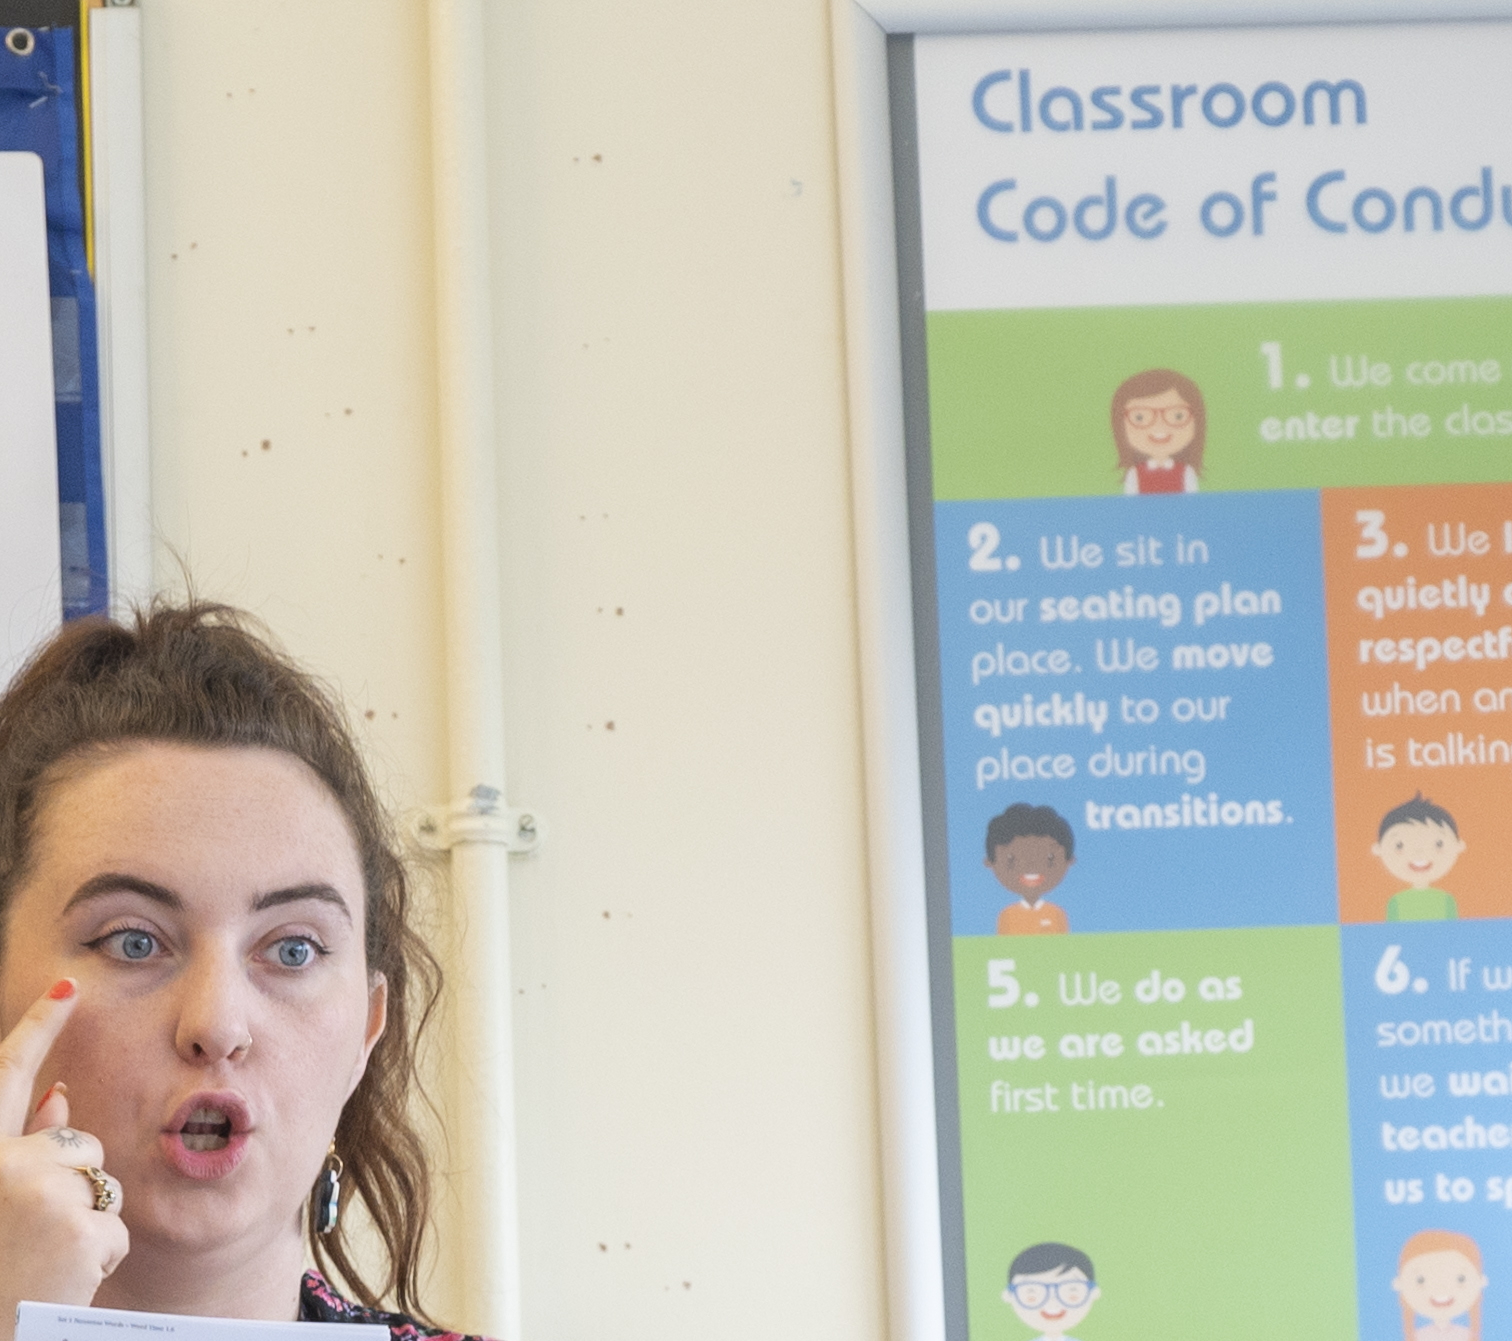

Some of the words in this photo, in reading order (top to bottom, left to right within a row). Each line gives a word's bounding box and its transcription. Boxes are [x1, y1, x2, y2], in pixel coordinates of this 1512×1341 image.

[971, 68, 1367, 133] Classroom
[975, 175, 1167, 243] Code
[1199, 171, 1277, 238] of
[1257, 339, 1312, 392] 1.
[1327, 353, 1393, 390] We
[1403, 358, 1502, 386] come
[1257, 409, 1360, 444] enter
[1370, 405, 1432, 439] the
[1354, 508, 1408, 560] 3.
[1427, 522, 1490, 557] We
[1355, 574, 1490, 620] quietly
[1360, 681, 1461, 717] when
[1364, 738, 1396, 769] is
[986, 958, 1039, 1009] 5.
[1057, 971, 1122, 1006] We
[1133, 969, 1186, 1004] do
[1196, 975, 1243, 1002] as
[987, 1033, 1046, 1061] we
[1057, 1031, 1124, 1059] are
[1135, 1017, 1254, 1057] asked
[989, 1079, 1059, 1113] first
[1069, 1079, 1164, 1111] time.
